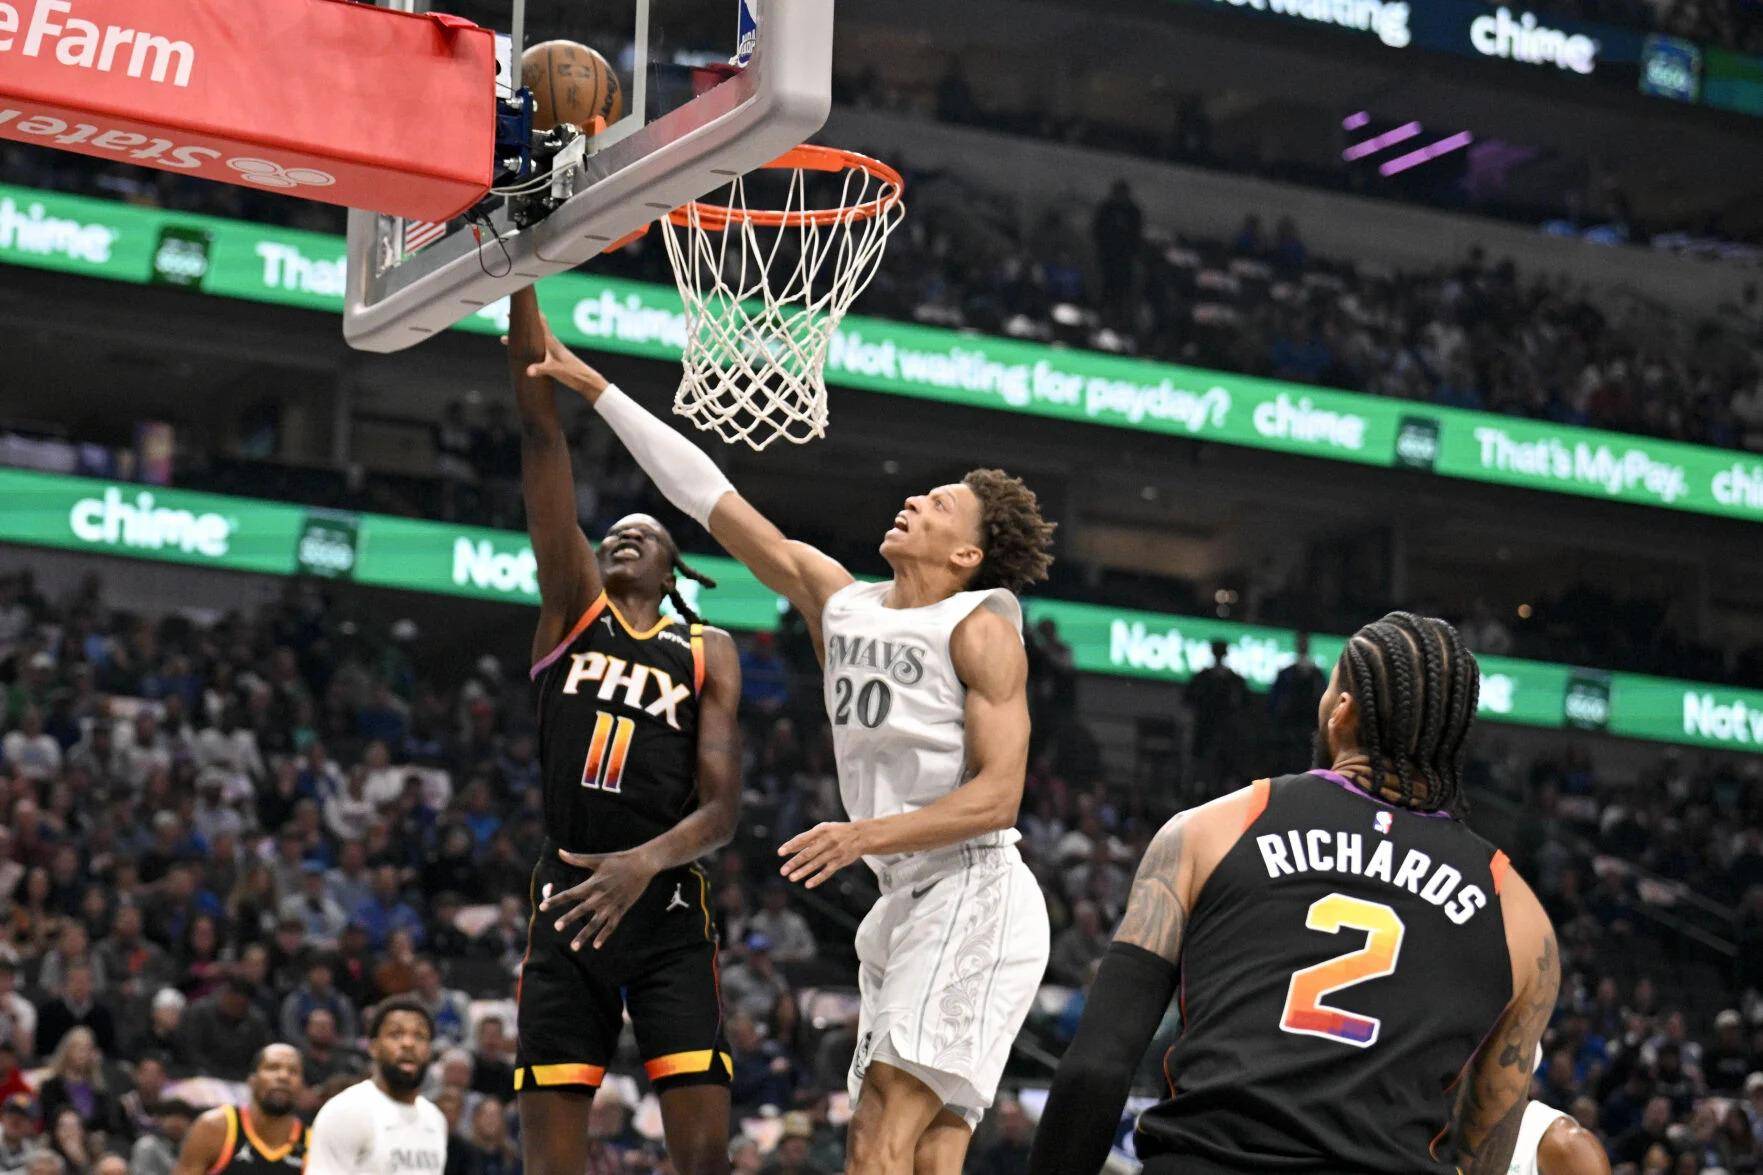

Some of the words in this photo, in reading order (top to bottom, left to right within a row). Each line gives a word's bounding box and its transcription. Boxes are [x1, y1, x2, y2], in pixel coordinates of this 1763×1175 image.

[1469, 8, 1597, 74] chime
[826, 332, 896, 378] Not
[899, 347, 1031, 407] waiting
[1033, 359, 1084, 402] for
[1084, 377, 1232, 432] payday?
[1253, 392, 1366, 449] chime
[69, 486, 230, 558] chime
[452, 536, 540, 595] Not
[829, 633, 927, 686] MAVS
[1110, 619, 1186, 673] Not
[563, 651, 691, 731] PHX
[834, 676, 892, 729] 20
[1683, 689, 1750, 743] Not
[581, 709, 636, 793] 11
[1256, 829, 1487, 925] RICHARDS
[1279, 892, 1405, 1048] 2
